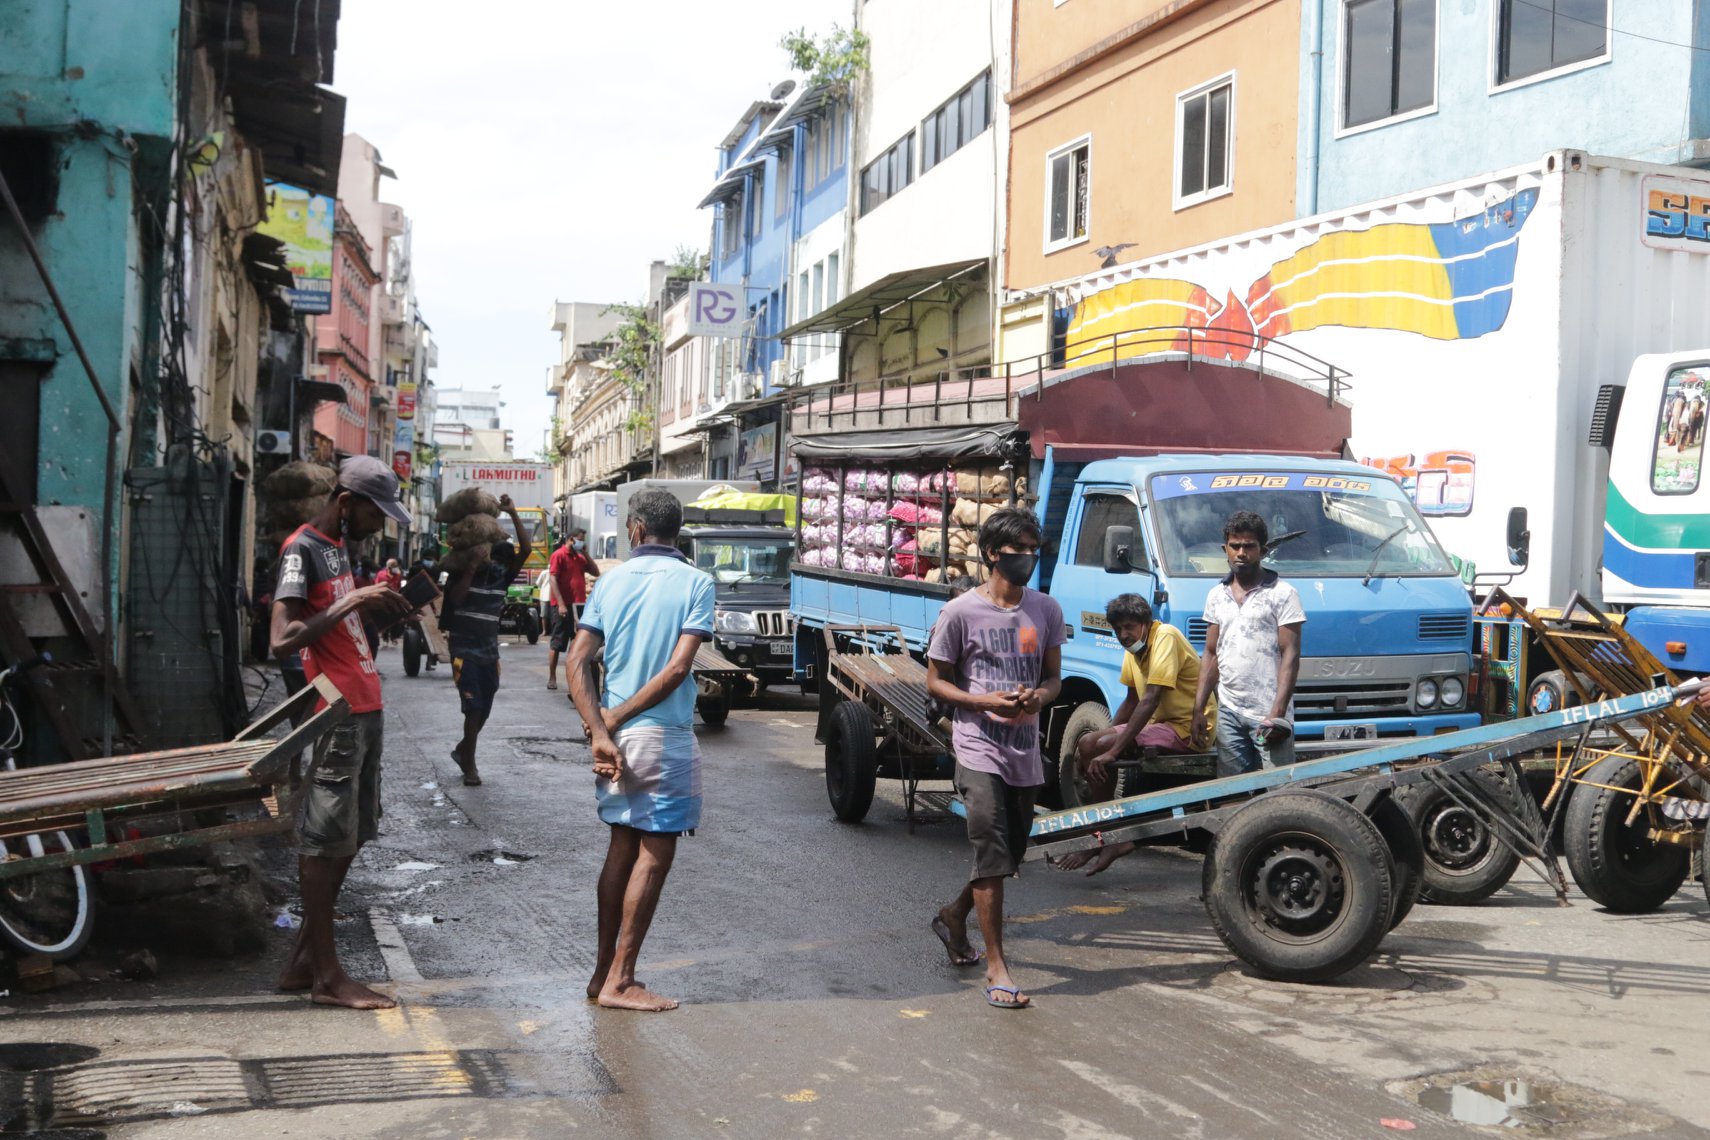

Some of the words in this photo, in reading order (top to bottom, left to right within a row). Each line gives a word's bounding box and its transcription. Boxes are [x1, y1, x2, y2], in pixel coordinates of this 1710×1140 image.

[696, 289, 736, 324] RG
[472, 469, 536, 481] LAKMUTHU
[988, 628, 1016, 654] GOT
[1313, 659, 1376, 677] ISUZU
[1560, 698, 1629, 725] IFLAL
[1641, 686, 1672, 708] 104
